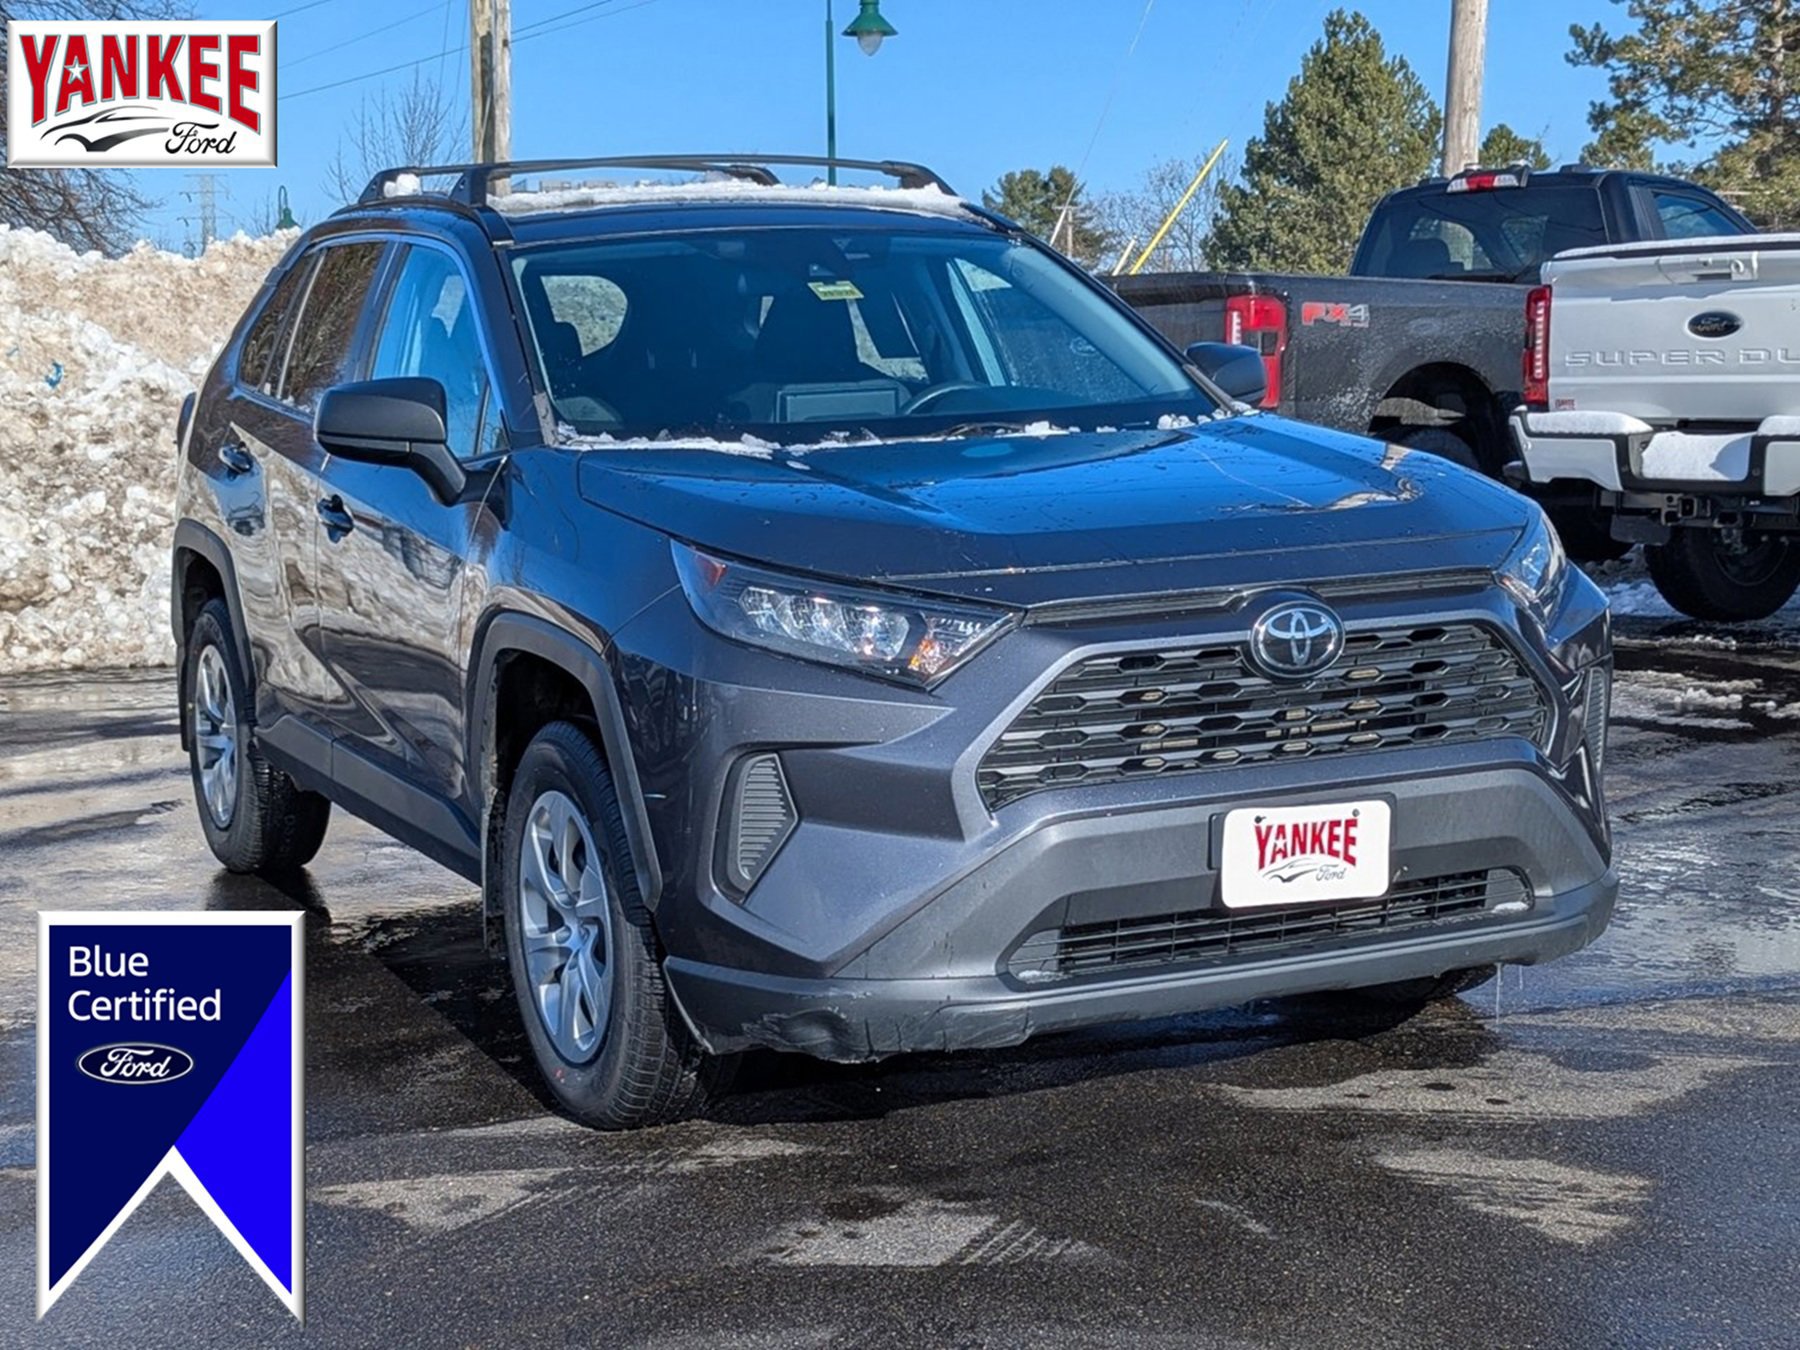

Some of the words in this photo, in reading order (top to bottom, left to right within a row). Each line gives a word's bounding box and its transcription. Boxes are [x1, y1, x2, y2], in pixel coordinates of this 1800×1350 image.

[1302, 302, 1369, 326] FX4
[1565, 350, 1725, 367] SUPER
[1254, 818, 1358, 871] YANKEE
[1316, 864, 1346, 881] Ford
